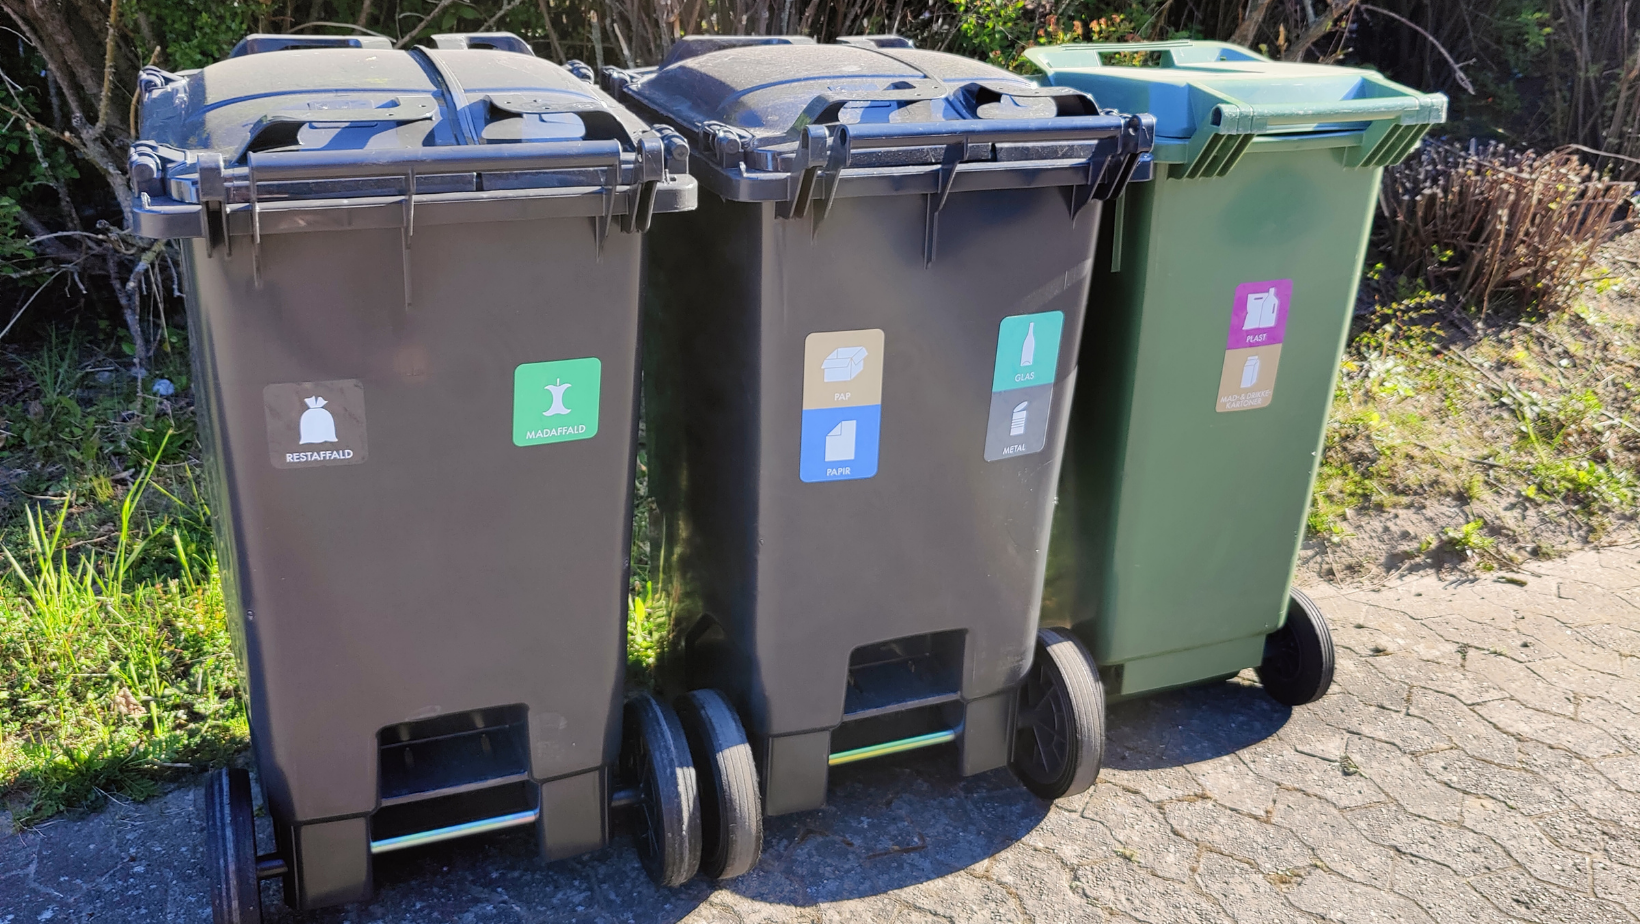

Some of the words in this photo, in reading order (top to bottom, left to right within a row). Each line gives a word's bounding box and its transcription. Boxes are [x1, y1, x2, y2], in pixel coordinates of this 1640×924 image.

[1246, 333, 1267, 343] PLAST
[1014, 371, 1035, 382] GLAS
[834, 392, 851, 401] PAP
[1225, 397, 1263, 409] KARTONER
[525, 424, 586, 440] MADAFFALD
[1002, 443, 1026, 455] METAL
[285, 449, 354, 463] RESTAFFALD
[826, 466, 851, 477] PAPIR
